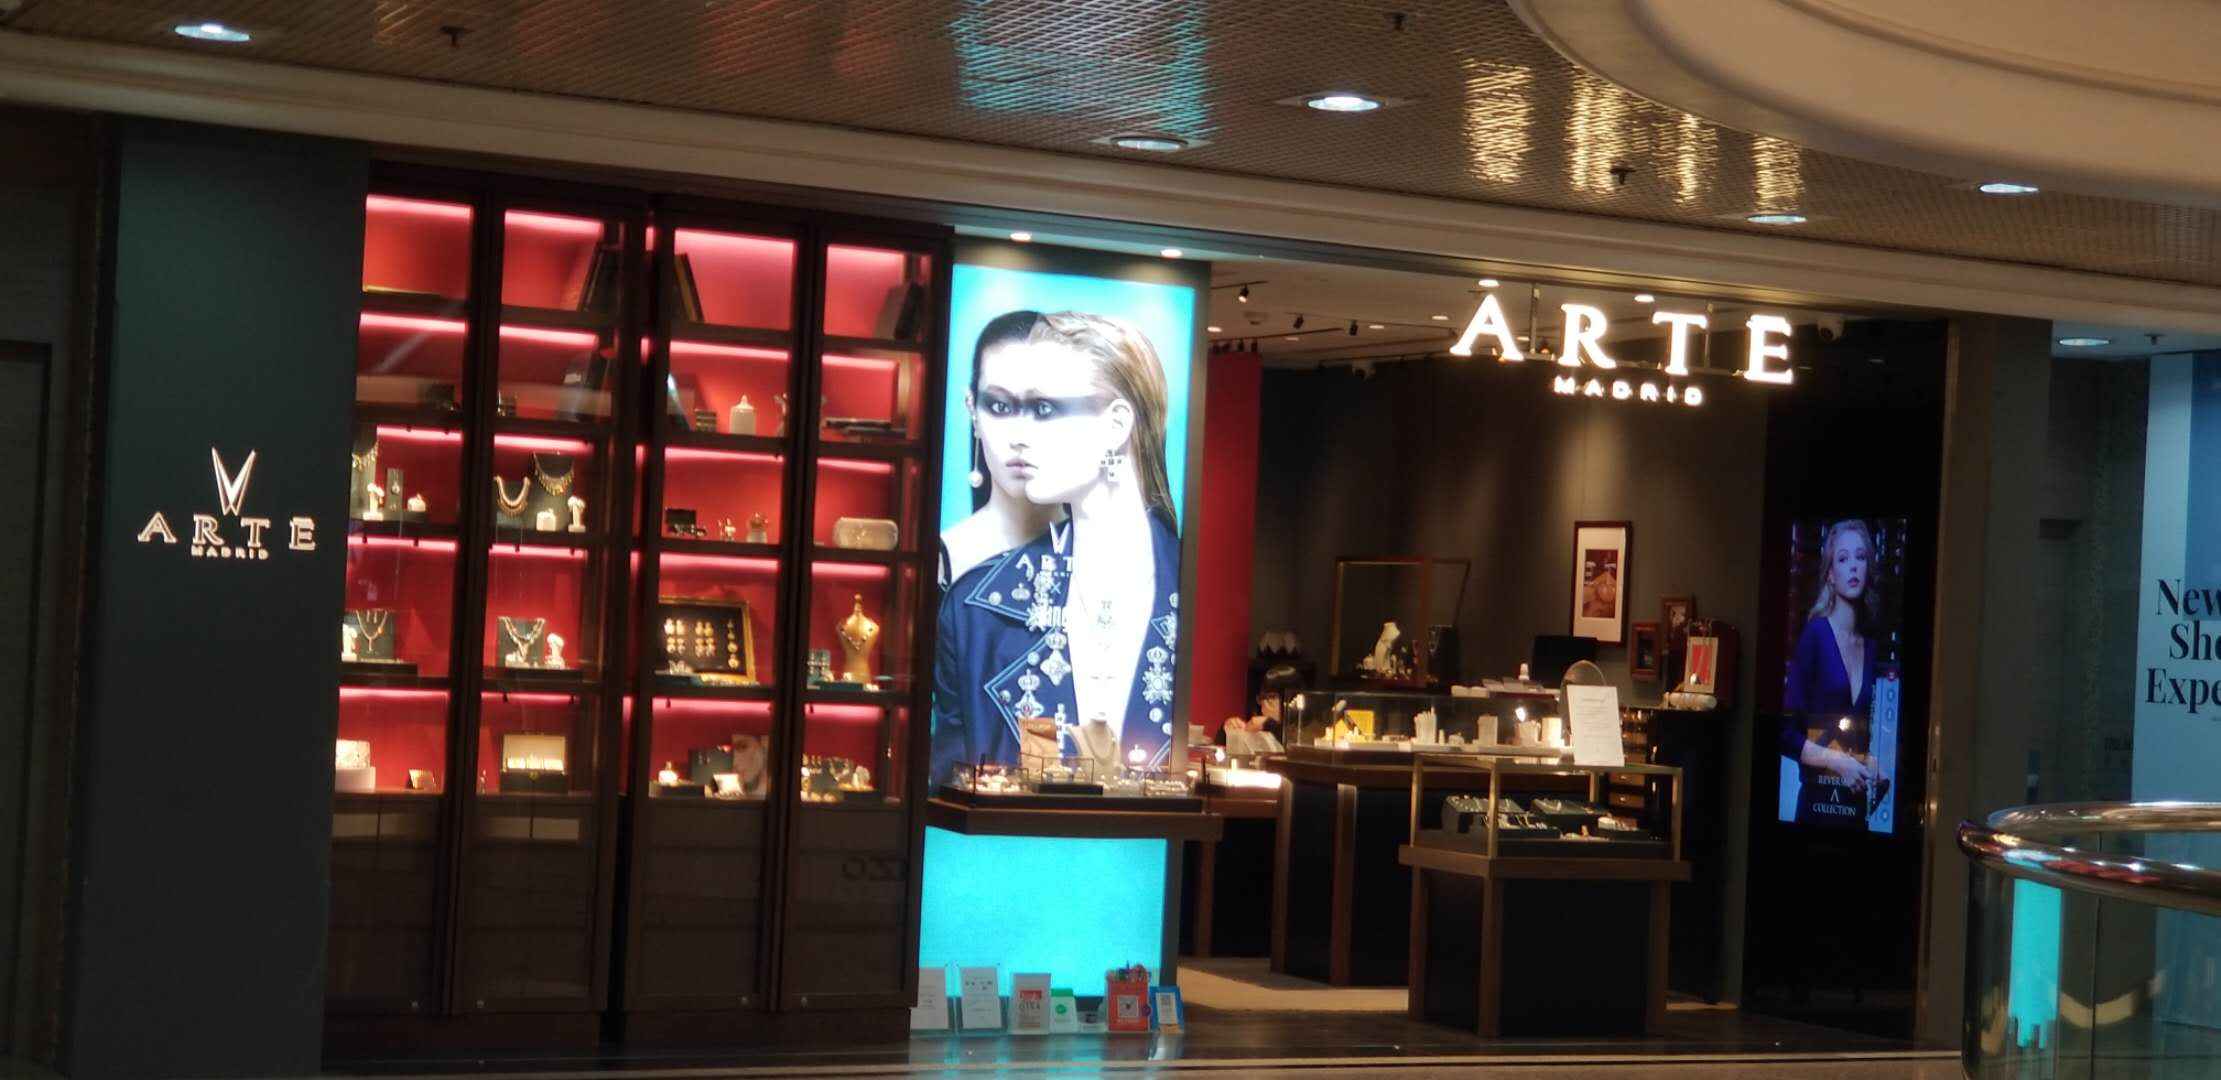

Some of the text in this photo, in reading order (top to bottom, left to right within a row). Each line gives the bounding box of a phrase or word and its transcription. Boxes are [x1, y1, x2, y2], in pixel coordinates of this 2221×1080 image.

[1449, 294, 1793, 383] ARTE
[1554, 378, 1703, 407] MADRID
[138, 512, 315, 550] ARTE
[191, 546, 268, 560] MADRID
